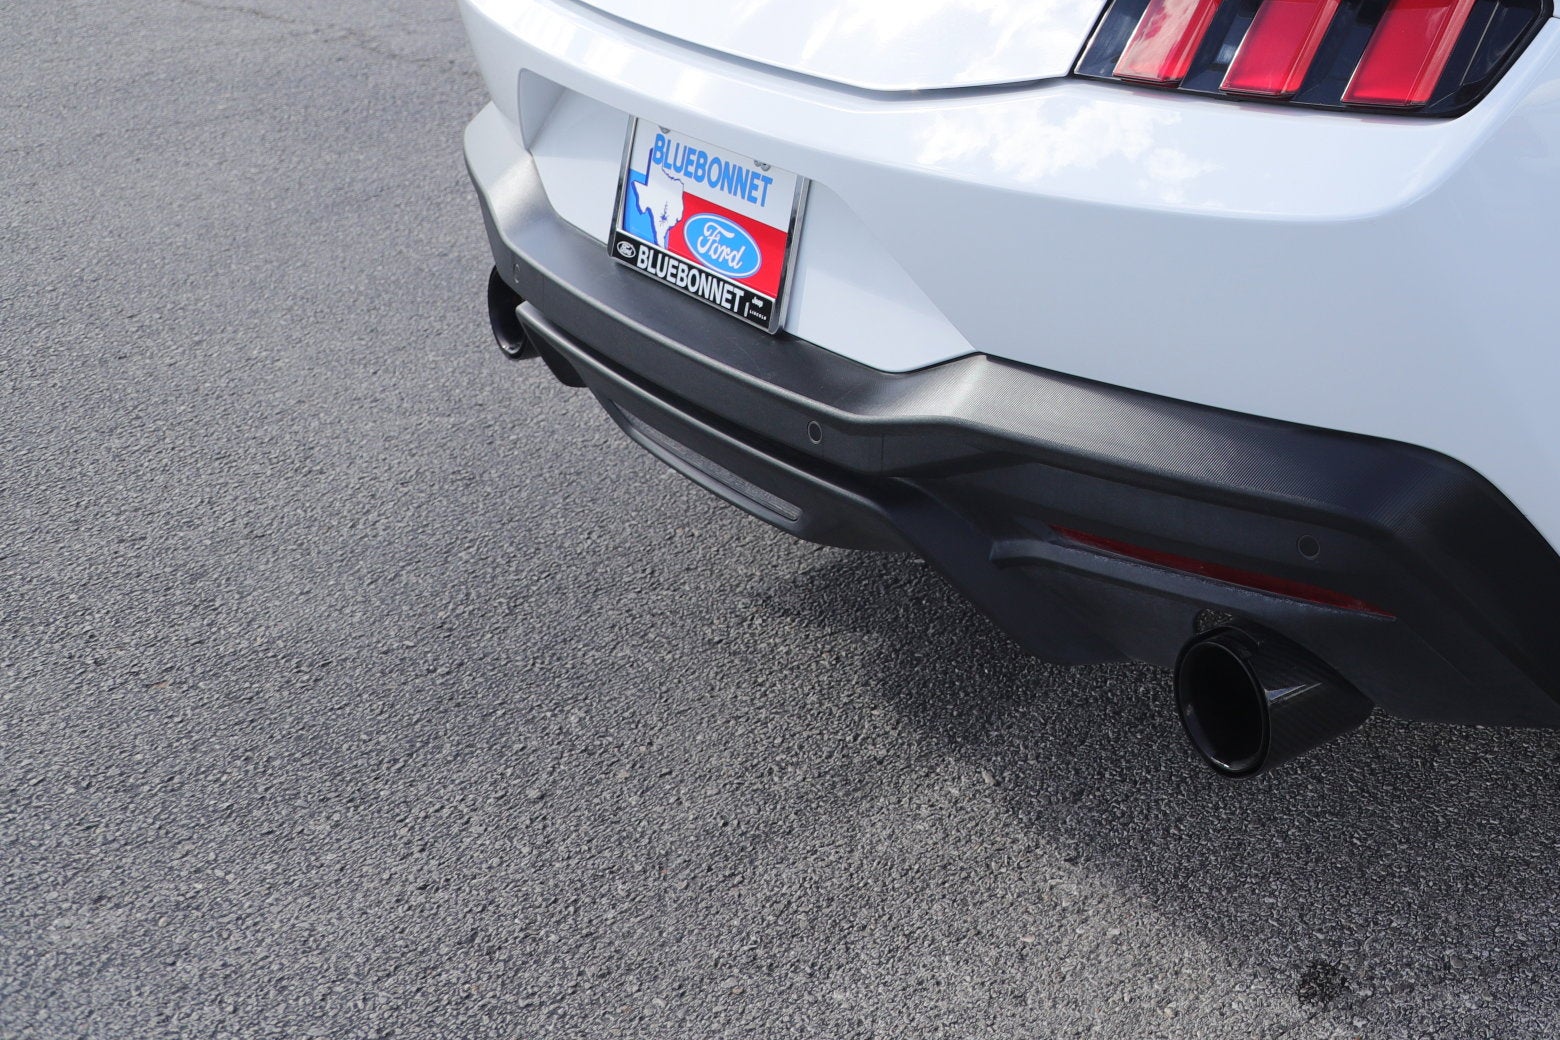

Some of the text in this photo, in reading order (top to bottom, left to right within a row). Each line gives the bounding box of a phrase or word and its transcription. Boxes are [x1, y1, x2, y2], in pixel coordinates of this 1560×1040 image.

[652, 133, 773, 208] BLUEBONNET
[637, 244, 744, 313] BLUEBONNET
[697, 221, 746, 270] Ford
